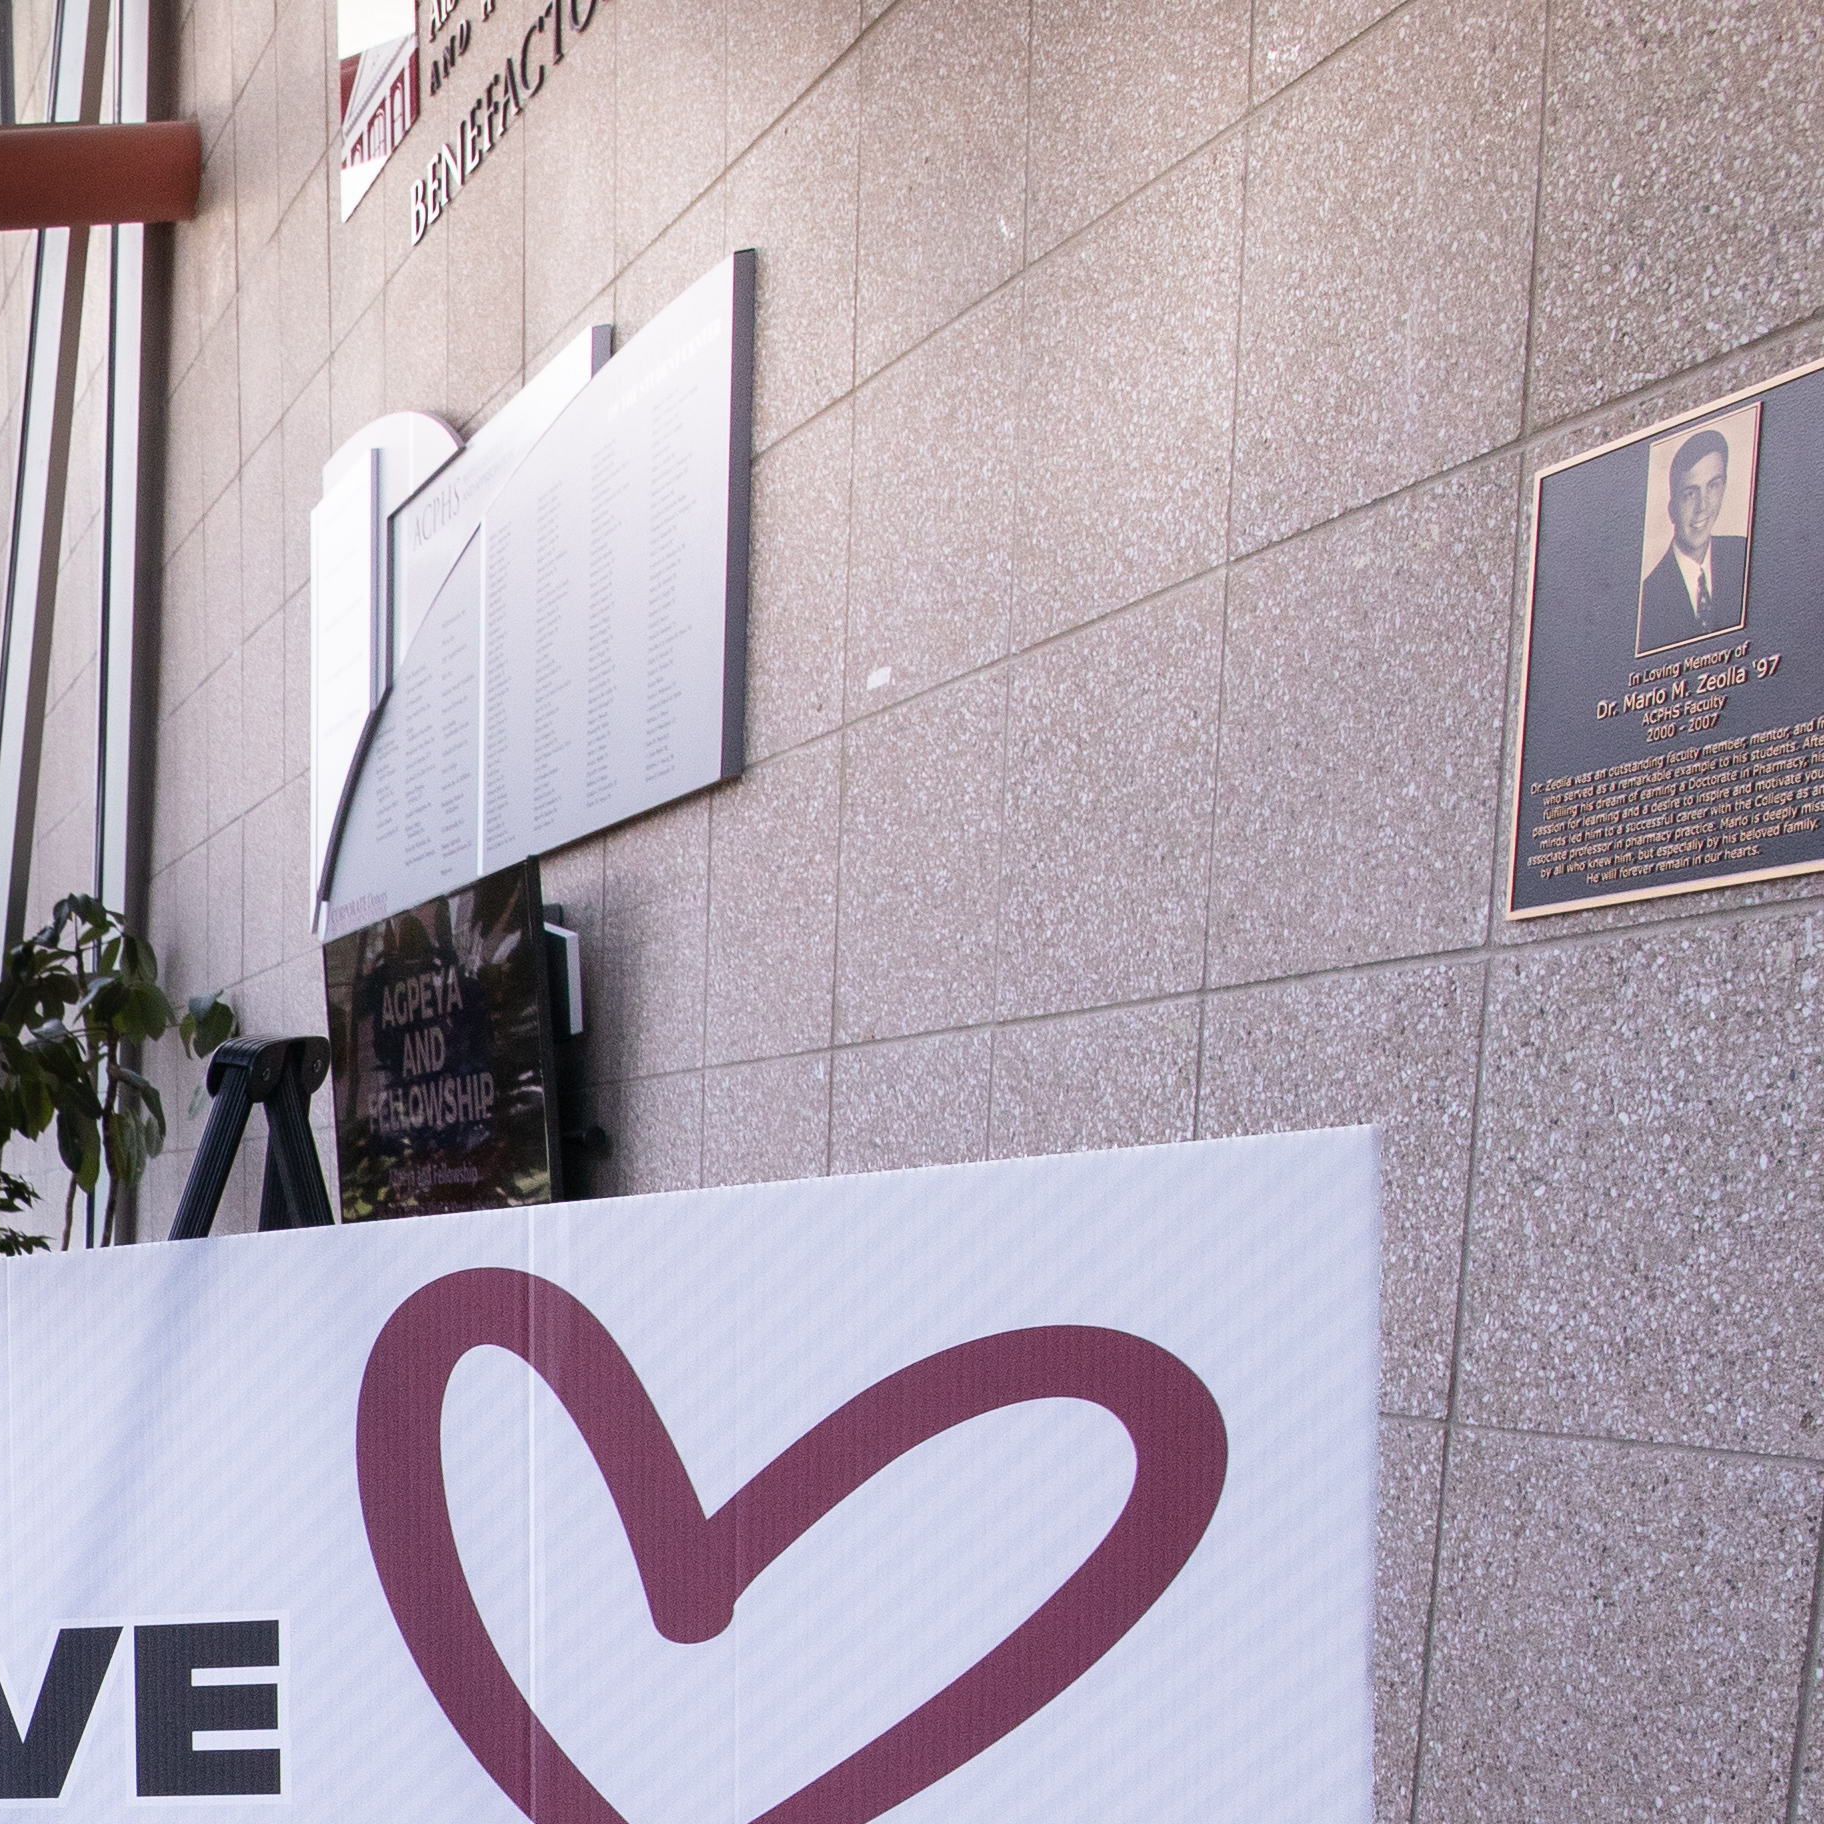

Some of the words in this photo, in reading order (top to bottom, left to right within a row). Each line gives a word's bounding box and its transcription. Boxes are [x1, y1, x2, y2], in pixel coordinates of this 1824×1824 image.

[430, 19, 471, 97] AND
[413, 476, 460, 551] ACPHS
[1627, 672, 1640, 687] In
[1643, 662, 1680, 683] Loving
[1683, 649, 1732, 671] Memory
[1734, 640, 1750, 657] of
[1596, 700, 1617, 720] Dr.
[1623, 687, 1666, 713] Mario
[1671, 679, 1690, 701] M.
[1696, 666, 1747, 694] Zeolla
[1641, 704, 1681, 726] ACPHS
[1683, 694, 1727, 716] Faculty
[1646, 722, 1677, 743] 2000
[1688, 712, 1720, 734] 2007
[1531, 782, 1544, 795] Dr.
[1574, 771, 1593, 785] was
[1594, 768, 1608, 780] an
[1609, 755, 1666, 777] outstanding
[1666, 748, 1702, 764] faculty
[1702, 737, 1748, 757] member,
[1750, 726, 1792, 746] mentor,
[1793, 718, 1815, 736] and
[1540, 868, 1552, 880] by
[1553, 862, 1567, 876] all
[1566, 861, 1587, 873] who
[1587, 857, 1614, 870] knew
[1638, 846, 1655, 861] but
[1656, 837, 1705, 859] especially
[1706, 836, 1720, 849] by
[1722, 832, 1738, 845] his
[1739, 824, 1782, 842] beloved
[1783, 817, 1820, 834] family.
[1586, 873, 1601, 885] He
[1601, 869, 1619, 882] will
[1619, 862, 1655, 878] forever
[1655, 857, 1690, 872] remain
[1691, 853, 1702, 866] in
[1703, 850, 1723, 864] our
[1724, 844, 1761, 860] hearts.
[402, 1025, 446, 1078] AND
[369, 1071, 494, 1133] FELLOWSHIP
